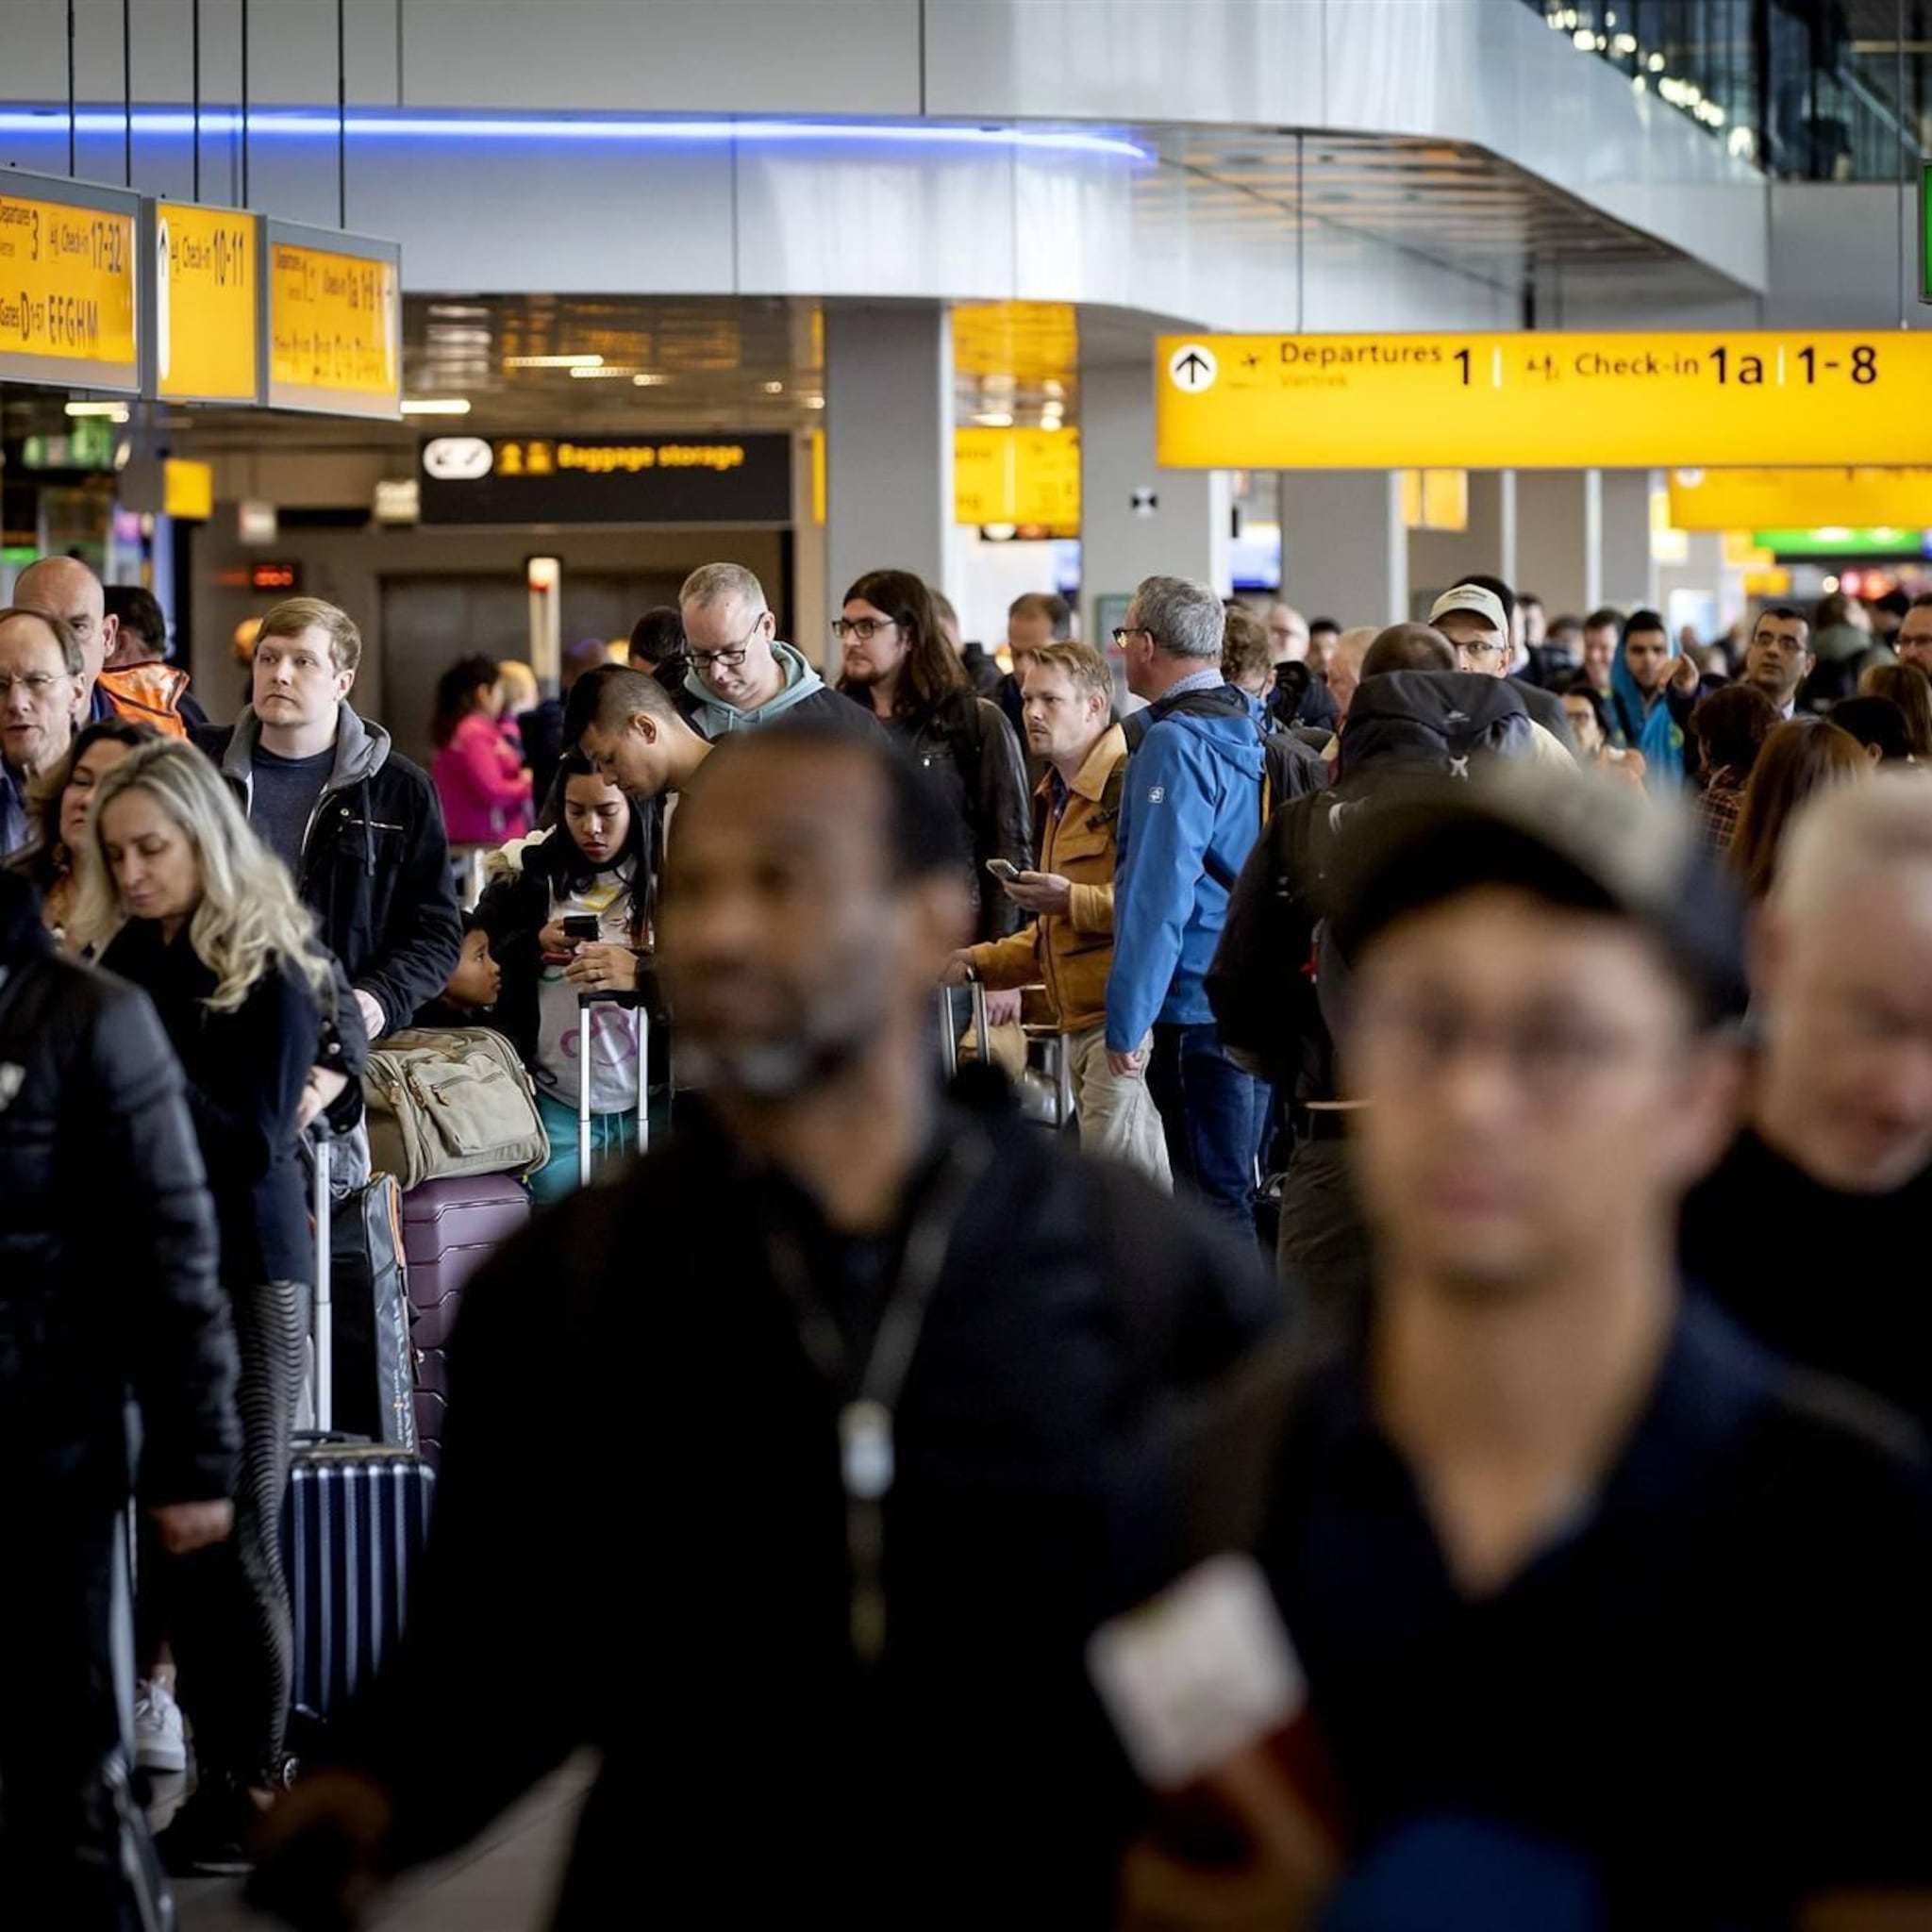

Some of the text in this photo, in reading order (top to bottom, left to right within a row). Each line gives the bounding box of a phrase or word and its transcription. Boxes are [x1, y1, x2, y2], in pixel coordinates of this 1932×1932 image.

[32, 209, 39, 261] 3
[92, 221, 122, 273] 17-32
[213, 228, 243, 287] 10-11
[1280, 341, 1442, 369] Departures
[1453, 348, 1471, 385] 1
[1574, 351, 1699, 376] Check-in
[1709, 345, 1764, 385] 1a
[558, 443, 744, 473] Baggage storage
[402, 1390, 413, 1453] HAN
